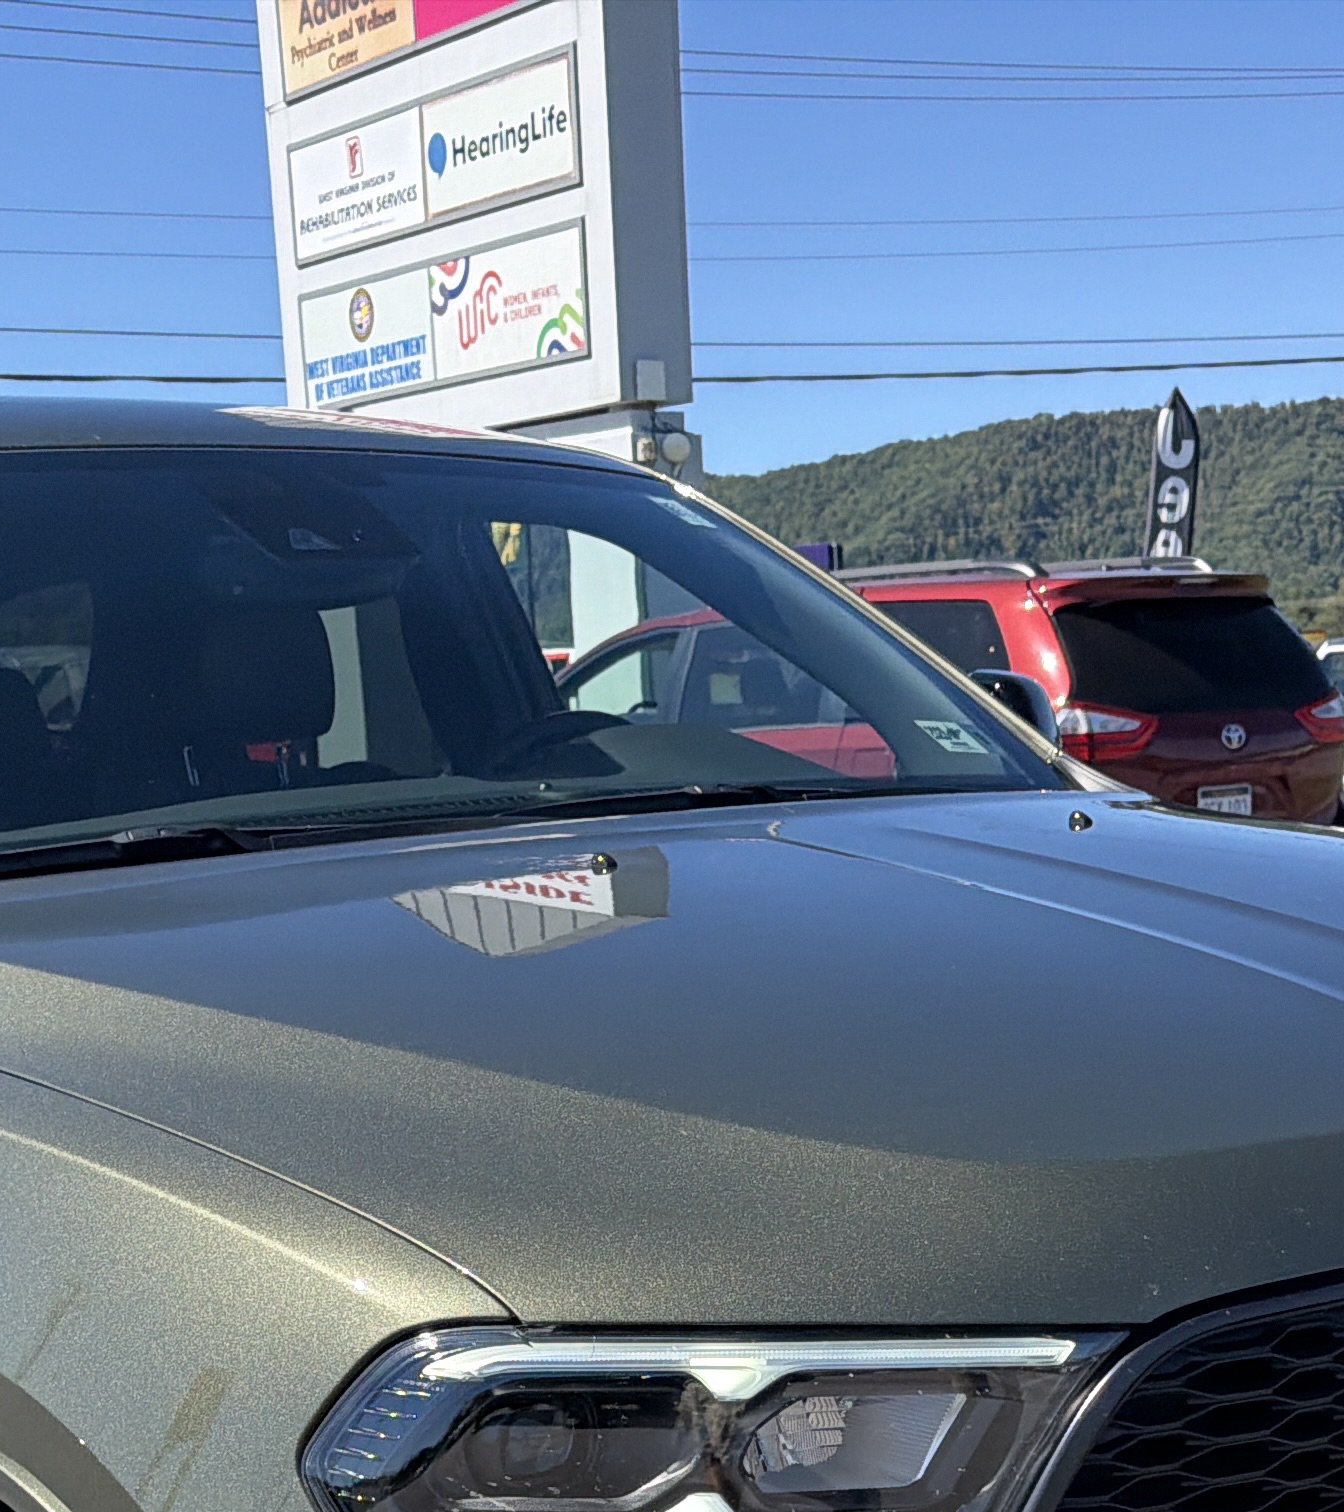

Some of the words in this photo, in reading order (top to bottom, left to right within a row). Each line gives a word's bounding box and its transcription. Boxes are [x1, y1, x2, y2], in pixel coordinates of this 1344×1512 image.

[338, 18, 354, 44] and
[355, 8, 396, 35] Wellness
[328, 49, 358, 71] Center
[452, 104, 567, 167] HearingLife
[300, 198, 373, 235] REHABILITATION
[376, 184, 417, 213] SERVICES
[510, 304, 542, 322] CHILDREN
[306, 358, 329, 380] WEST
[331, 349, 369, 375] VIRGINIA
[370, 334, 426, 366] DEPARTMENT
[315, 383, 324, 402] OF
[327, 373, 367, 399] VETERANS
[369, 360, 422, 390] ASSISTANCE
